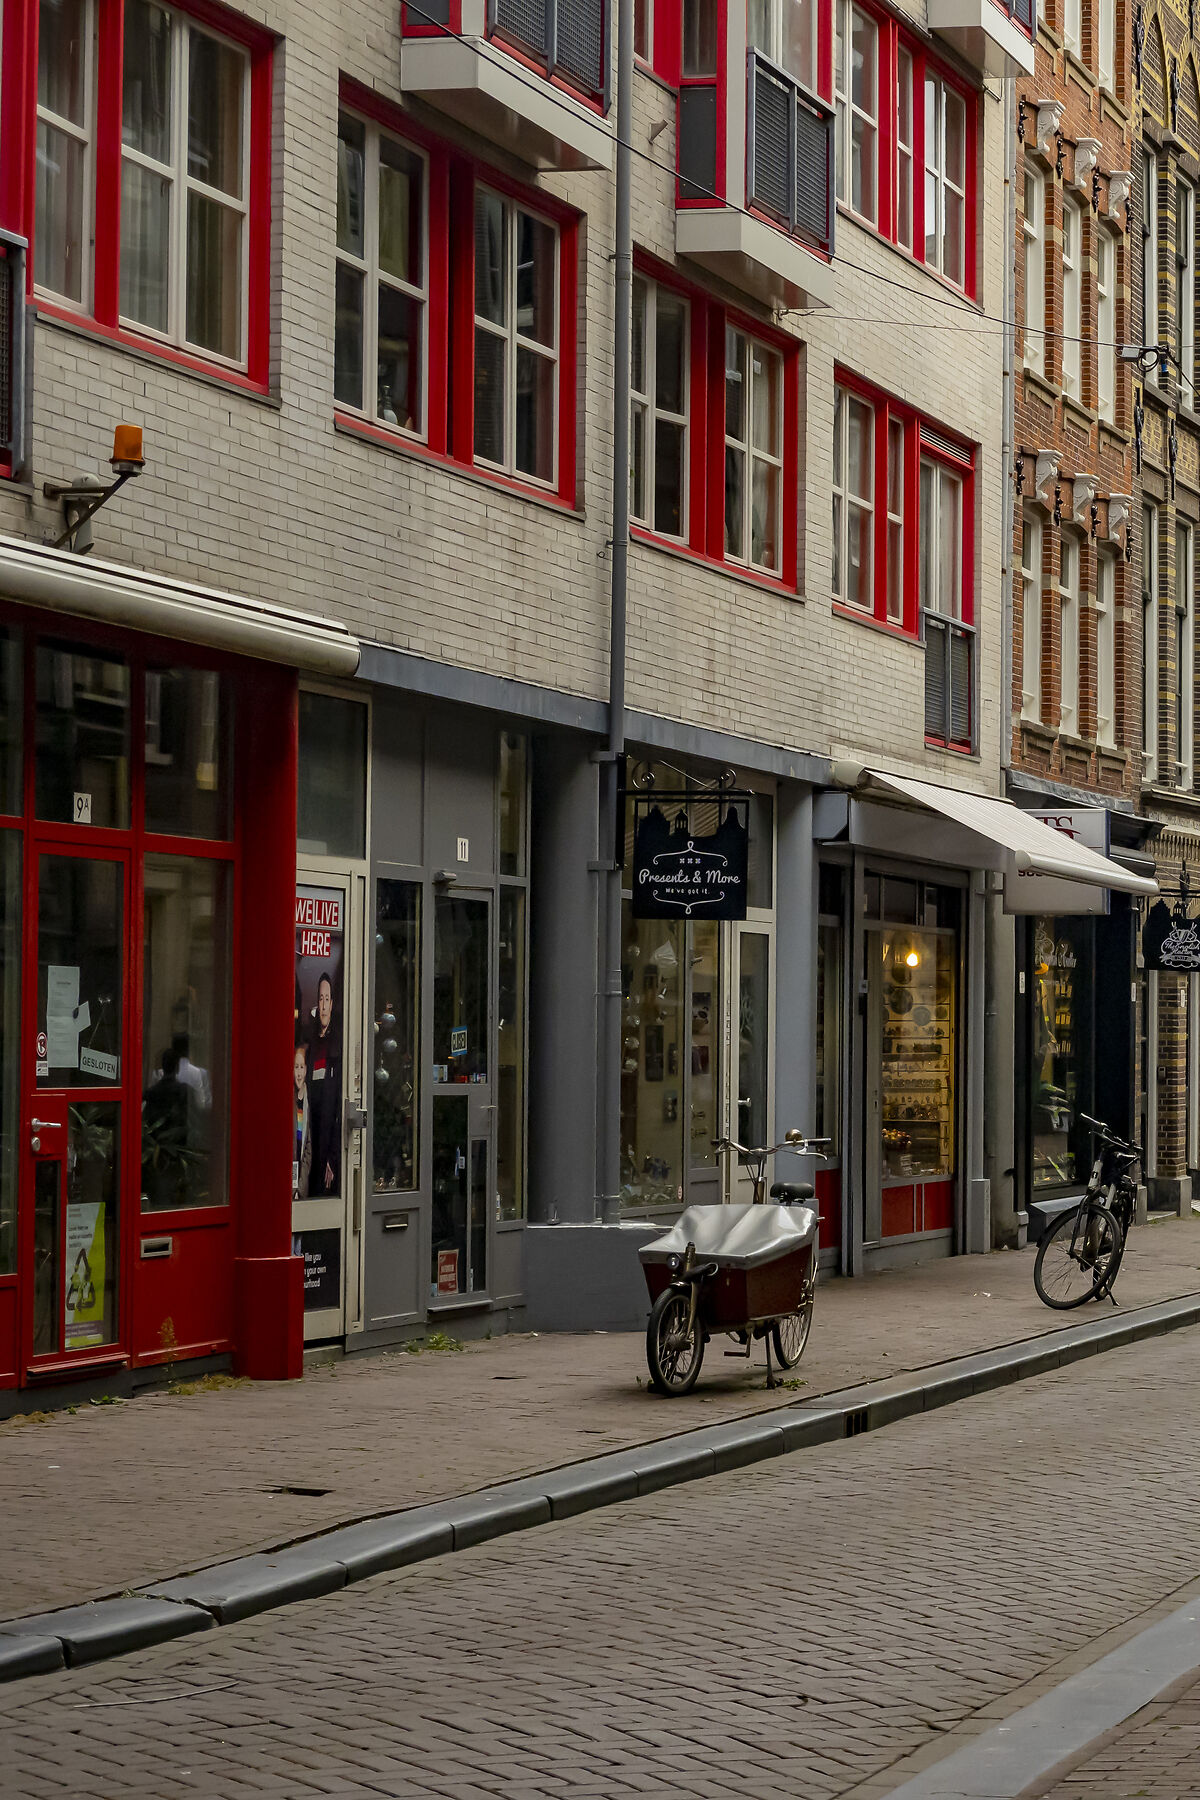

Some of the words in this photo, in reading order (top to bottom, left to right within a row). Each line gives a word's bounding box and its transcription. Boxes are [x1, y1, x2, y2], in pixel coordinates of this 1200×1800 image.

[76, 796, 89, 819] 9A
[638, 868, 691, 884] Presents
[692, 871, 702, 883] &
[706, 870, 741, 884] More
[687, 888, 700, 896] got
[296, 900, 313, 924] WE
[314, 902, 339, 926] LIVE
[301, 931, 331, 956] HERE
[82, 1055, 116, 1074] GESLOTEN
